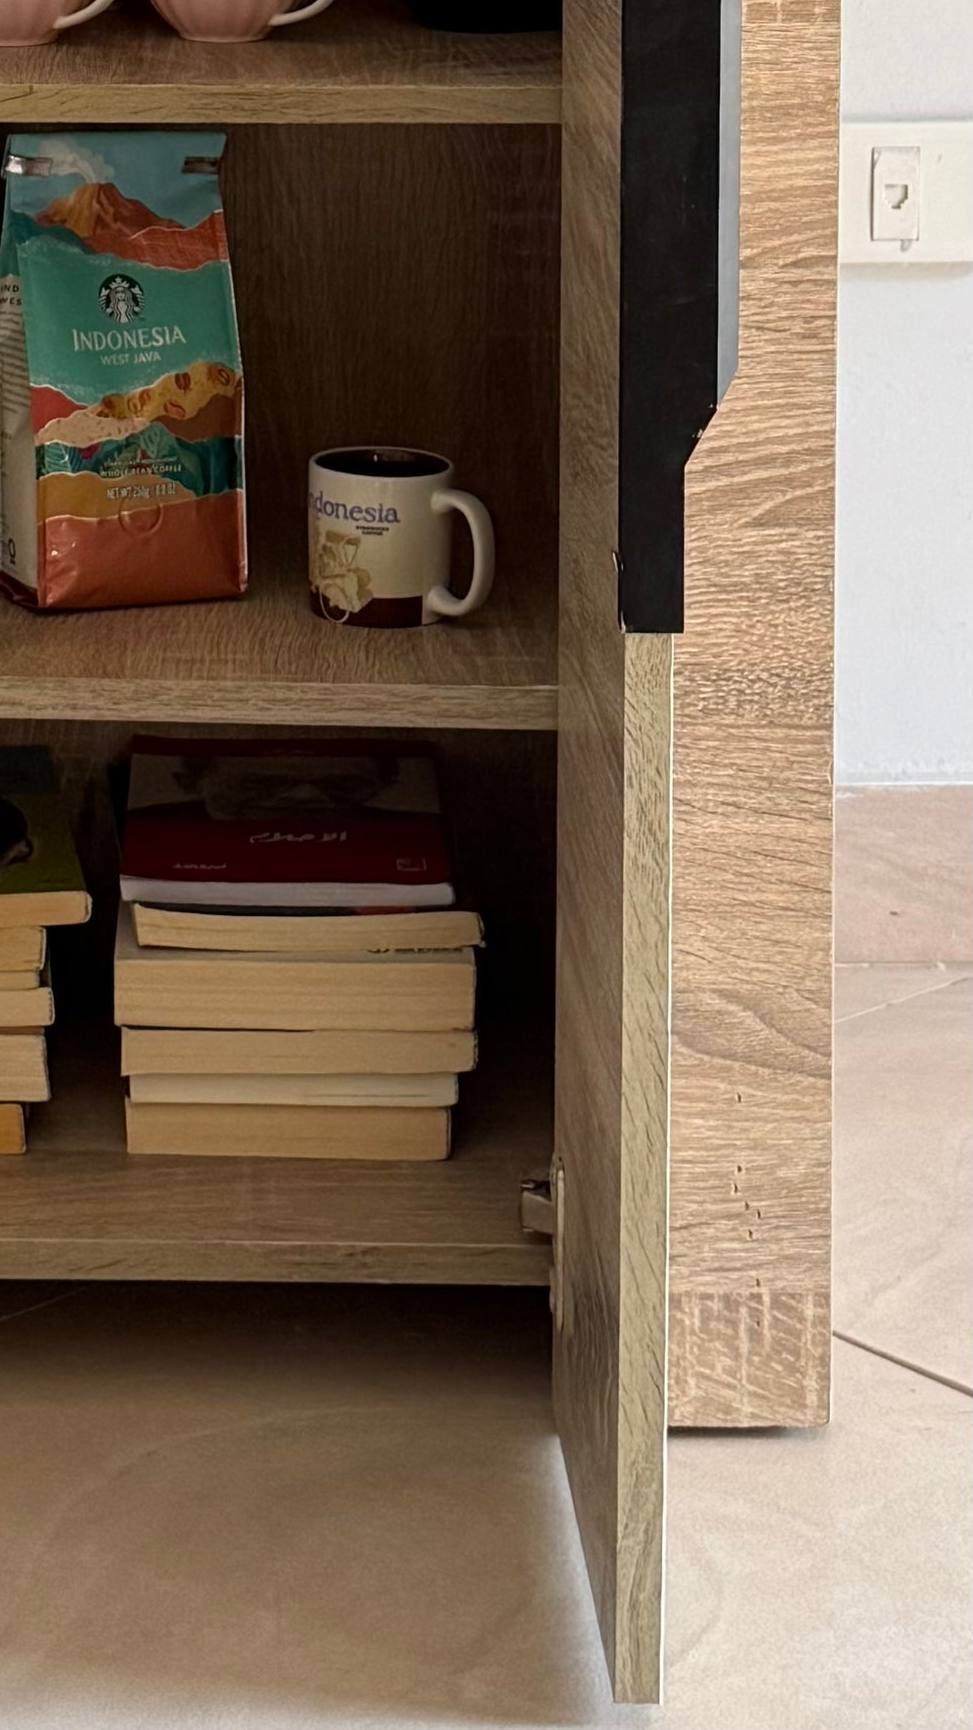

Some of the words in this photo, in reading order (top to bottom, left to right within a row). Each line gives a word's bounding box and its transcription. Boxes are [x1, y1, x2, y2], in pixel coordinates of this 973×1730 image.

[0, 284, 20, 293] IND
[72, 325, 187, 351] INDONESIA
[100, 353, 129, 366] WEST
[133, 351, 162, 364] JAVA
[307, 491, 401, 523] ndonesia
